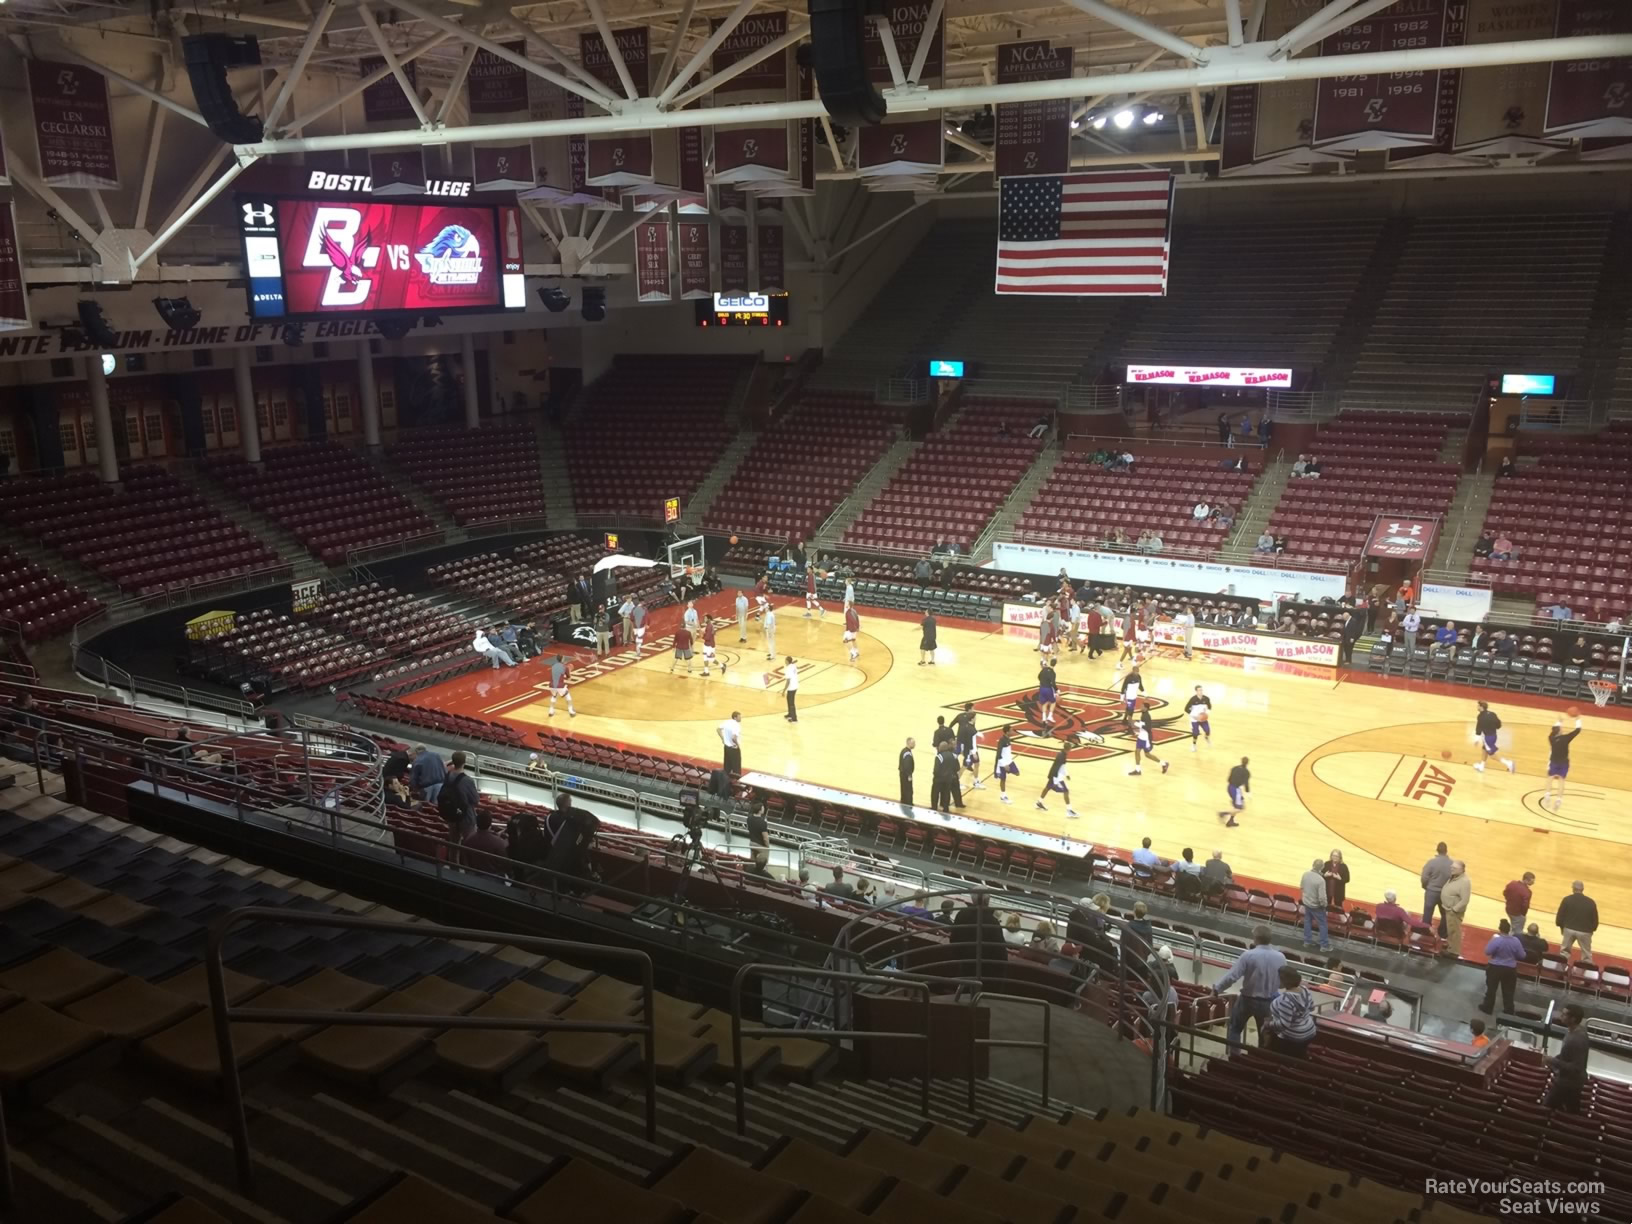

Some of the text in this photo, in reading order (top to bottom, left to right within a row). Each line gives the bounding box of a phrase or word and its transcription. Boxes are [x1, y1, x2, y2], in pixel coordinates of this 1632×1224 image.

[1394, 20, 1429, 32] 1982
[1337, 40, 1371, 51] 1967
[1392, 36, 1427, 48] 1983
[1011, 46, 1059, 63] NCAA
[1003, 60, 1065, 73] APPEARANCES
[1333, 87, 1364, 97] 1981
[1388, 84, 1423, 96] 1996
[62, 111, 82, 121] LEN
[41, 121, 107, 137] CEGLARSKI
[387, 245, 410, 270] VS
[506, 263, 520, 271] enjoy
[718, 297, 765, 306] GEICO
[163, 326, 230, 347] HOME
[234, 325, 263, 342] OF
[667, 507, 678, 521] 30
